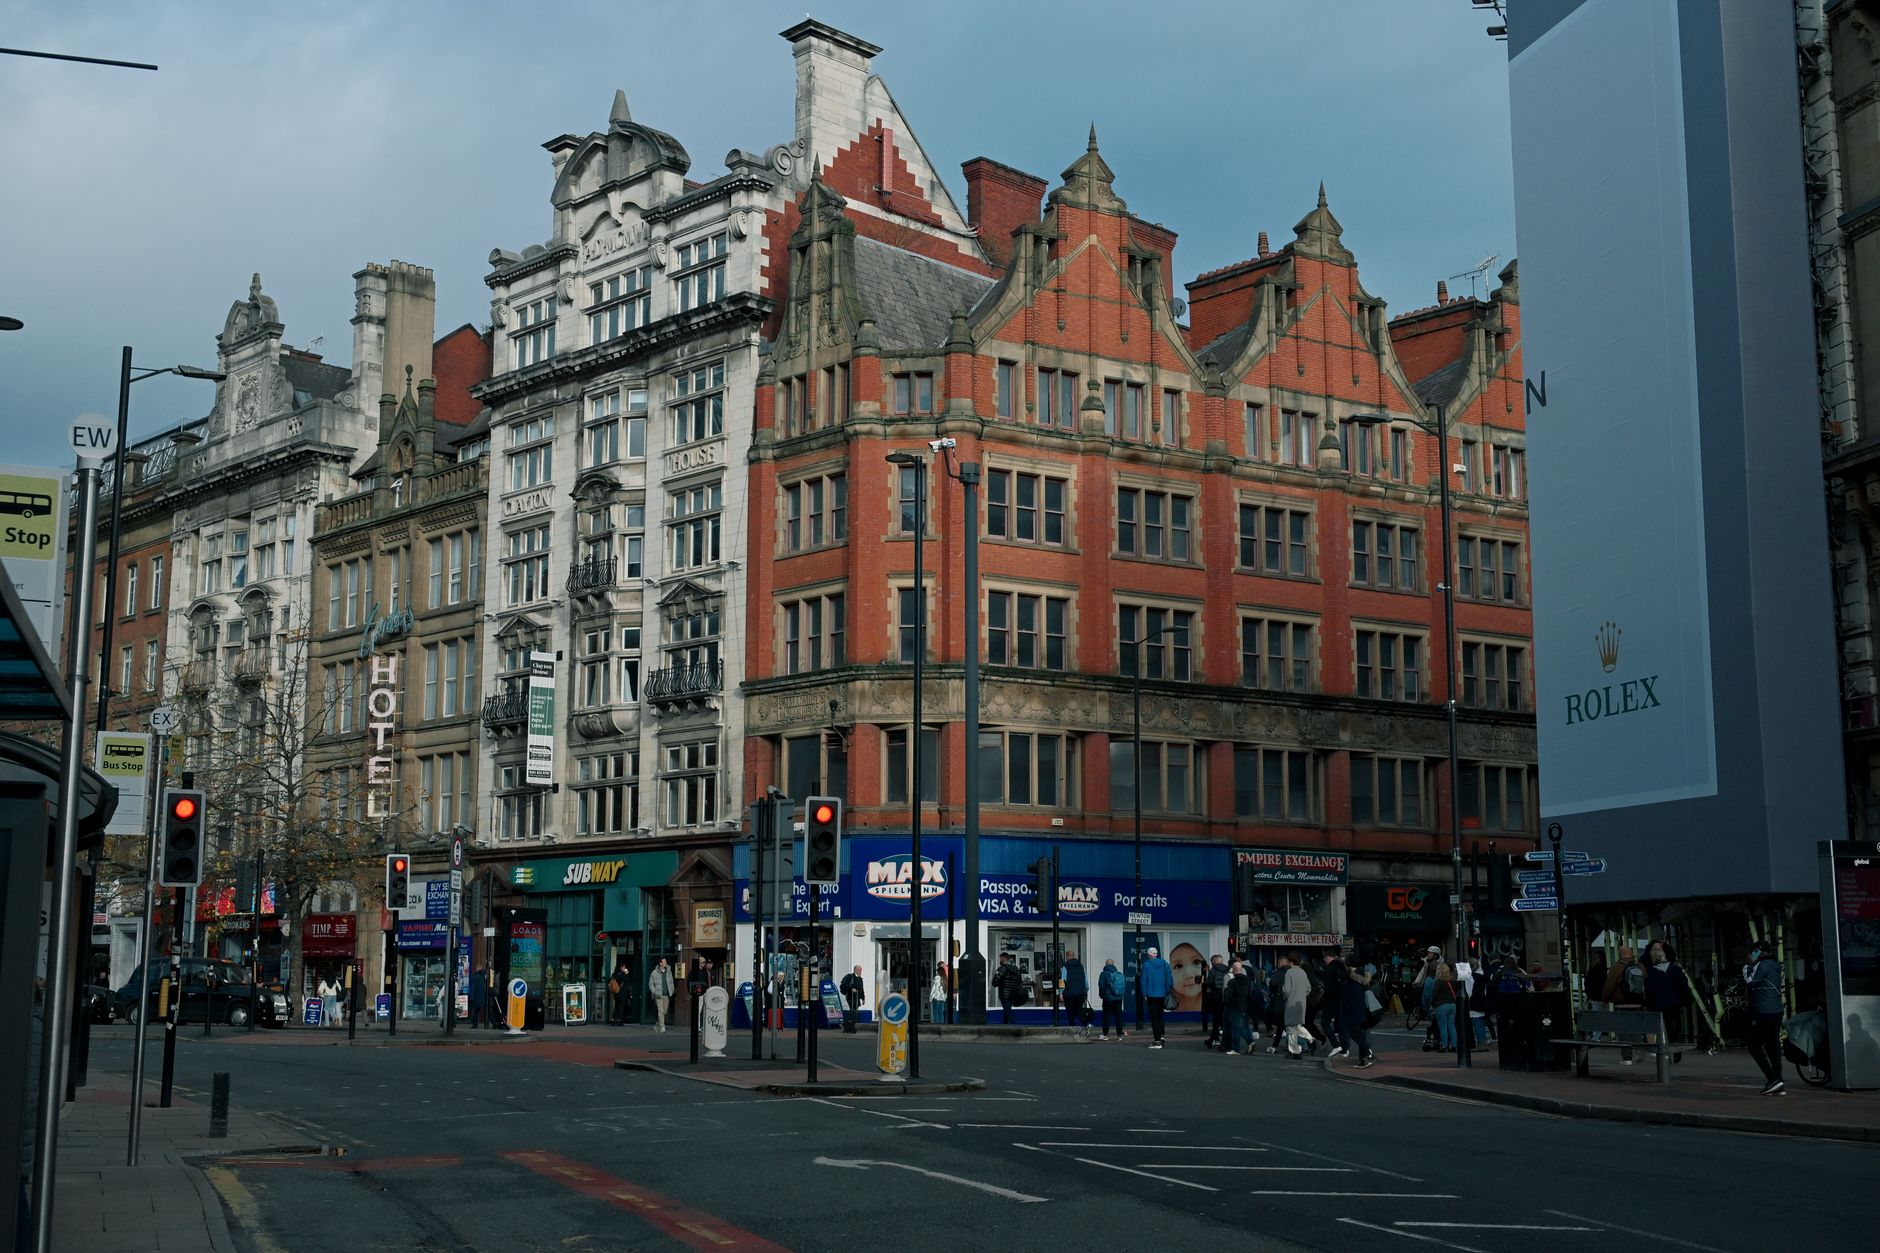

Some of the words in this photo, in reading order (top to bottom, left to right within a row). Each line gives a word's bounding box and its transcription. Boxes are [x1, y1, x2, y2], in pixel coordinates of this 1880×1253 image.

[1526, 370, 1547, 415] N
[73, 426, 112, 448] EW
[672, 446, 715, 474] HOUSE
[503, 488, 553, 517] CLAYTON
[4, 527, 51, 549] Stop
[1565, 675, 1661, 725] ROLEX
[152, 713, 171, 725] EX
[368, 651, 398, 818] HOTEL
[103, 761, 120, 770] Bus
[122, 761, 143, 772] Stop
[1236, 852, 1282, 867] EMPIRE
[1285, 854, 1345, 872] EXCHANGE
[1854, 858, 1870, 867] global
[563, 859, 625, 885] SUBWAY
[868, 861, 945, 884] MAX
[1274, 871, 1296, 880] Centre
[1297, 871, 1339, 881] Memorabilia
[430, 882, 441, 890] BUY
[793, 881, 806, 896] he
[980, 879, 1038, 898] Passpo
[427, 892, 449, 900] EXCHAN
[1058, 886, 1099, 902] MAX
[1114, 892, 1168, 908] Porraits
[978, 898, 1010, 914] VISA
[1013, 899, 1024, 914] &
[1059, 902, 1097, 910] SPIELMANN
[697, 910, 722, 919] BUNDOBUST
[1384, 911, 1423, 919] FALAFEL
[312, 923, 331, 934] TIMP
[402, 922, 433, 933] VAPING
[513, 927, 541, 935] LOADS
[1257, 934, 1266, 943] WE
[1267, 934, 1280, 944] BUY
[1284, 934, 1293, 944] WE
[1293, 934, 1306, 944] SELL
[1311, 934, 1320, 944] WE
[1321, 934, 1340, 945] TRADE
